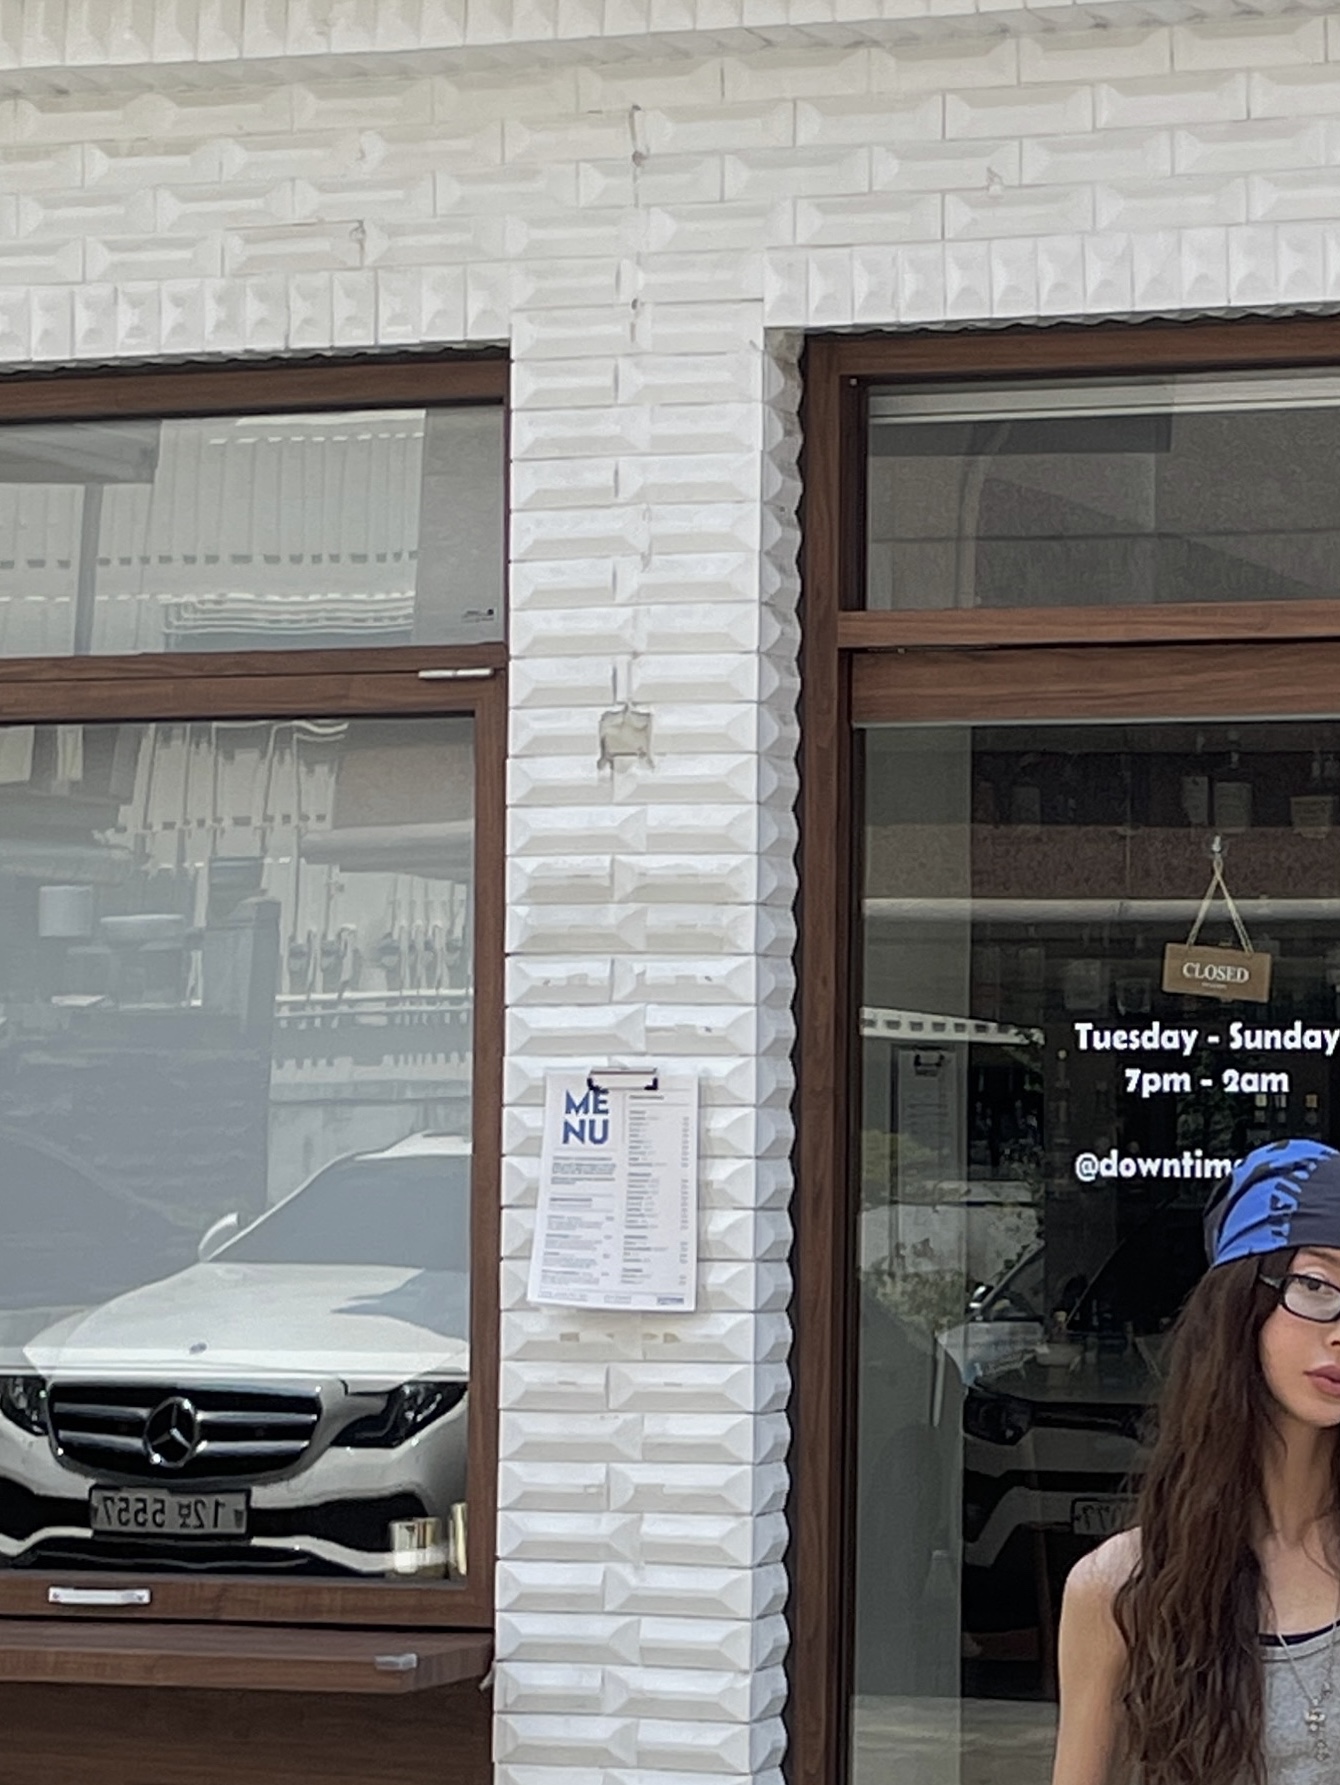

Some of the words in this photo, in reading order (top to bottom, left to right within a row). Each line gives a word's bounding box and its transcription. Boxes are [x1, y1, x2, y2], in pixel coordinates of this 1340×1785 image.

[1182, 961, 1250, 984] CLOSED
[1075, 1021, 1198, 1055] Tuesday
[1230, 1021, 1340, 1055] Sunday
[1125, 1069, 1191, 1098] 7pm
[1223, 1069, 1289, 1092] 2am
[565, 1088, 609, 1116] ME
[562, 1118, 609, 1144] NU
